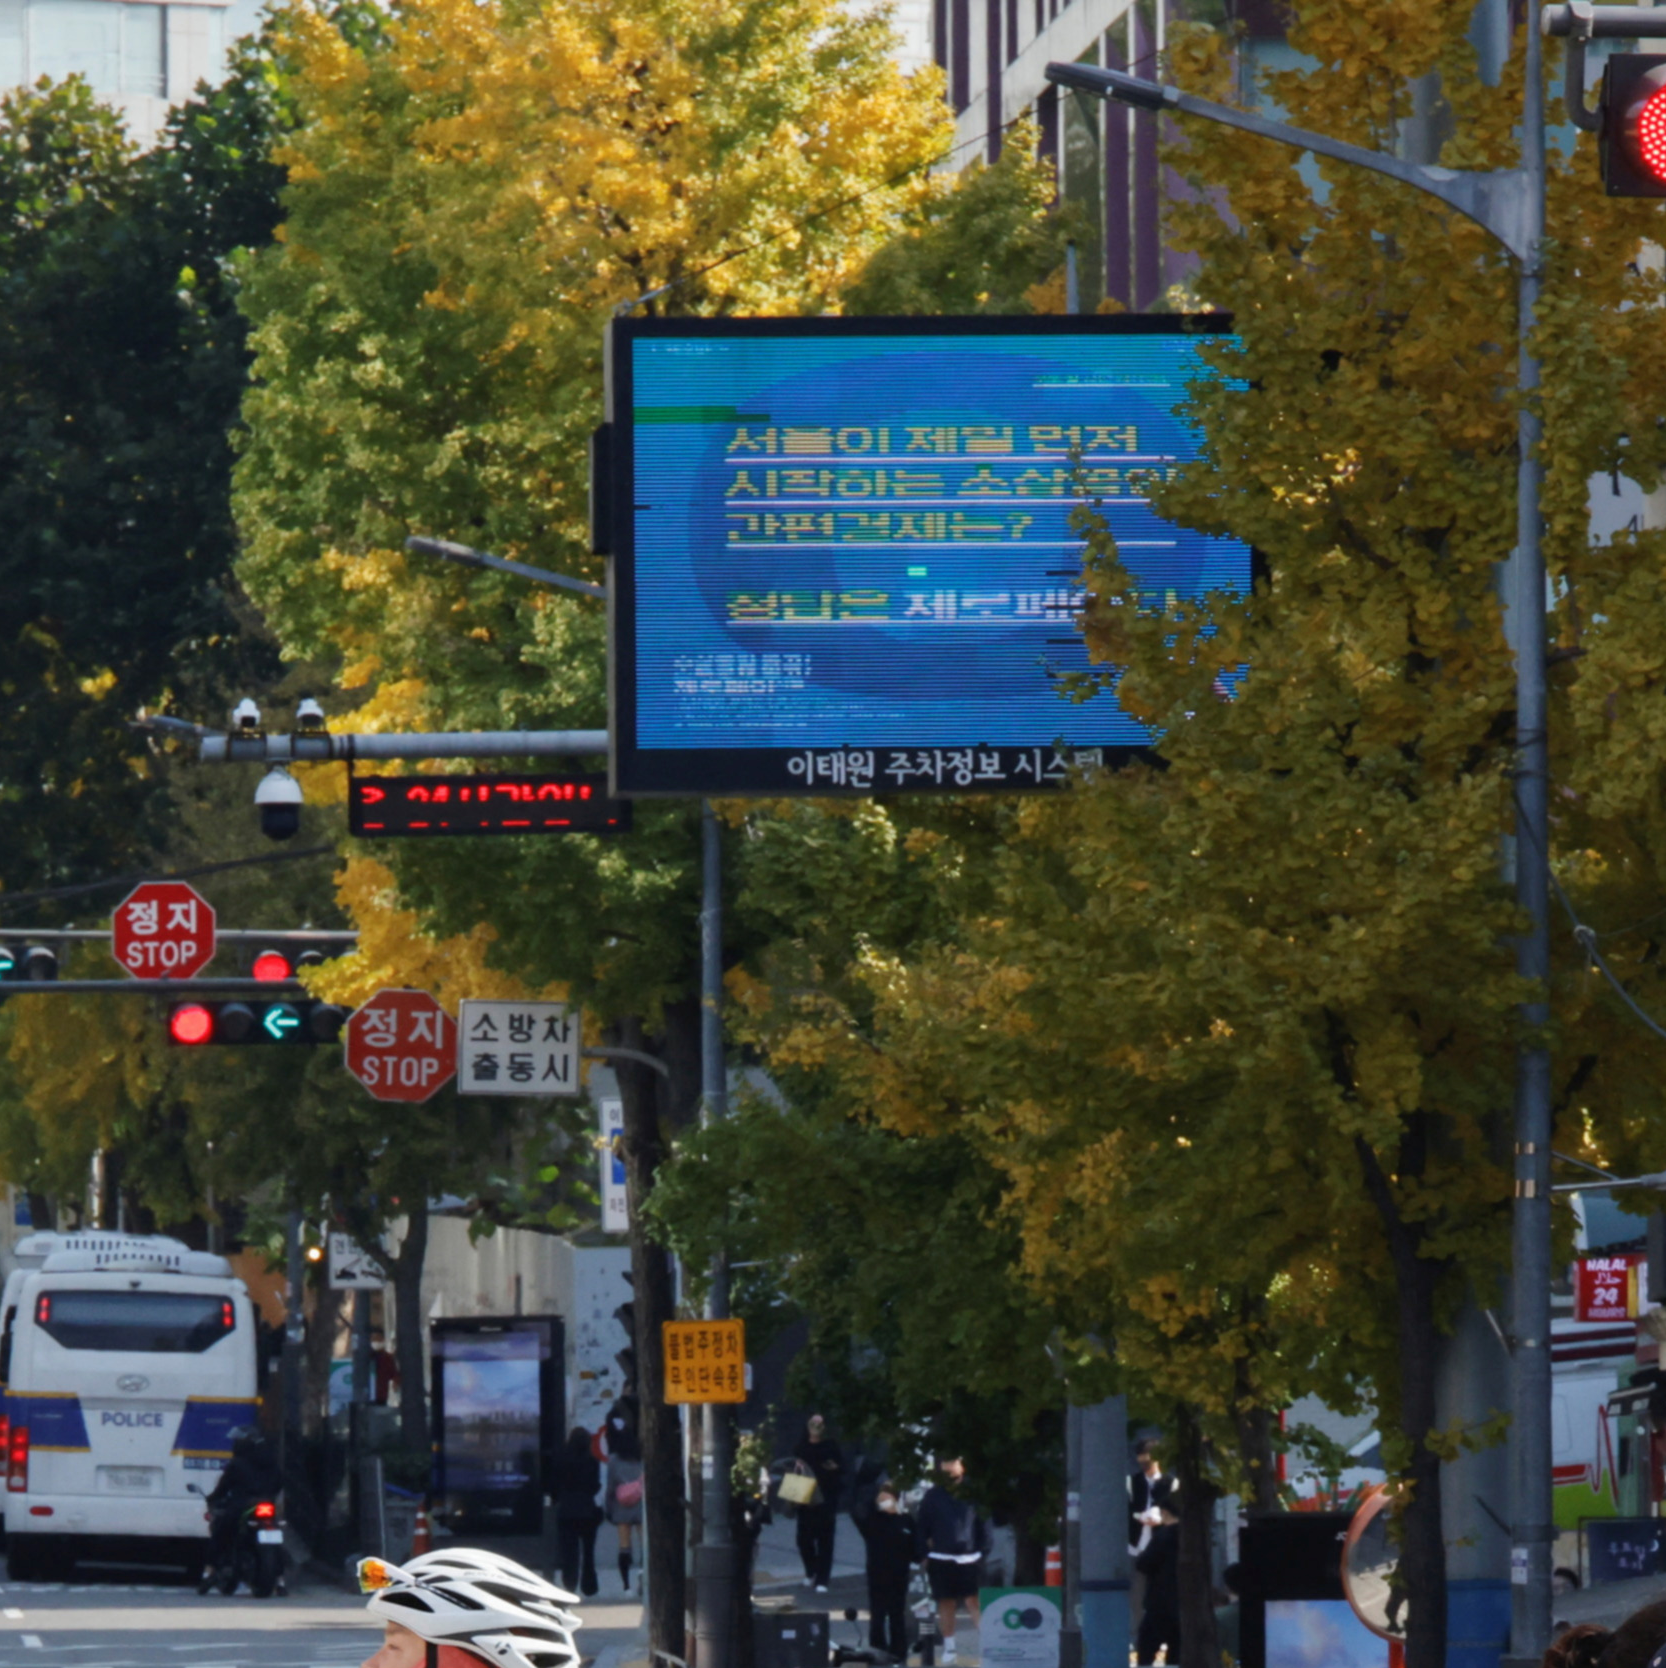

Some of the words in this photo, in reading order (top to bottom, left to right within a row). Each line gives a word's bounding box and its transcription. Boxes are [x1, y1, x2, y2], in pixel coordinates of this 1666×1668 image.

[726, 426, 890, 454] 서울이
[905, 426, 1015, 454] 제일
[1029, 425, 1138, 452] 먼저
[726, 468, 945, 497] 시작하는
[787, 749, 875, 789] 이태원
[884, 749, 1007, 788] 주차정보
[126, 900, 200, 937] 정지
[126, 939, 198, 969] STOP
[361, 1007, 444, 1050] 정지
[470, 1012, 572, 1044] 소방차
[362, 1055, 439, 1088] STOP
[471, 1052, 570, 1084] 출동시
[1587, 1258, 1627, 1271] HALAL
[1593, 1287, 1619, 1306] 24
[100, 1411, 163, 1428] POLICE
